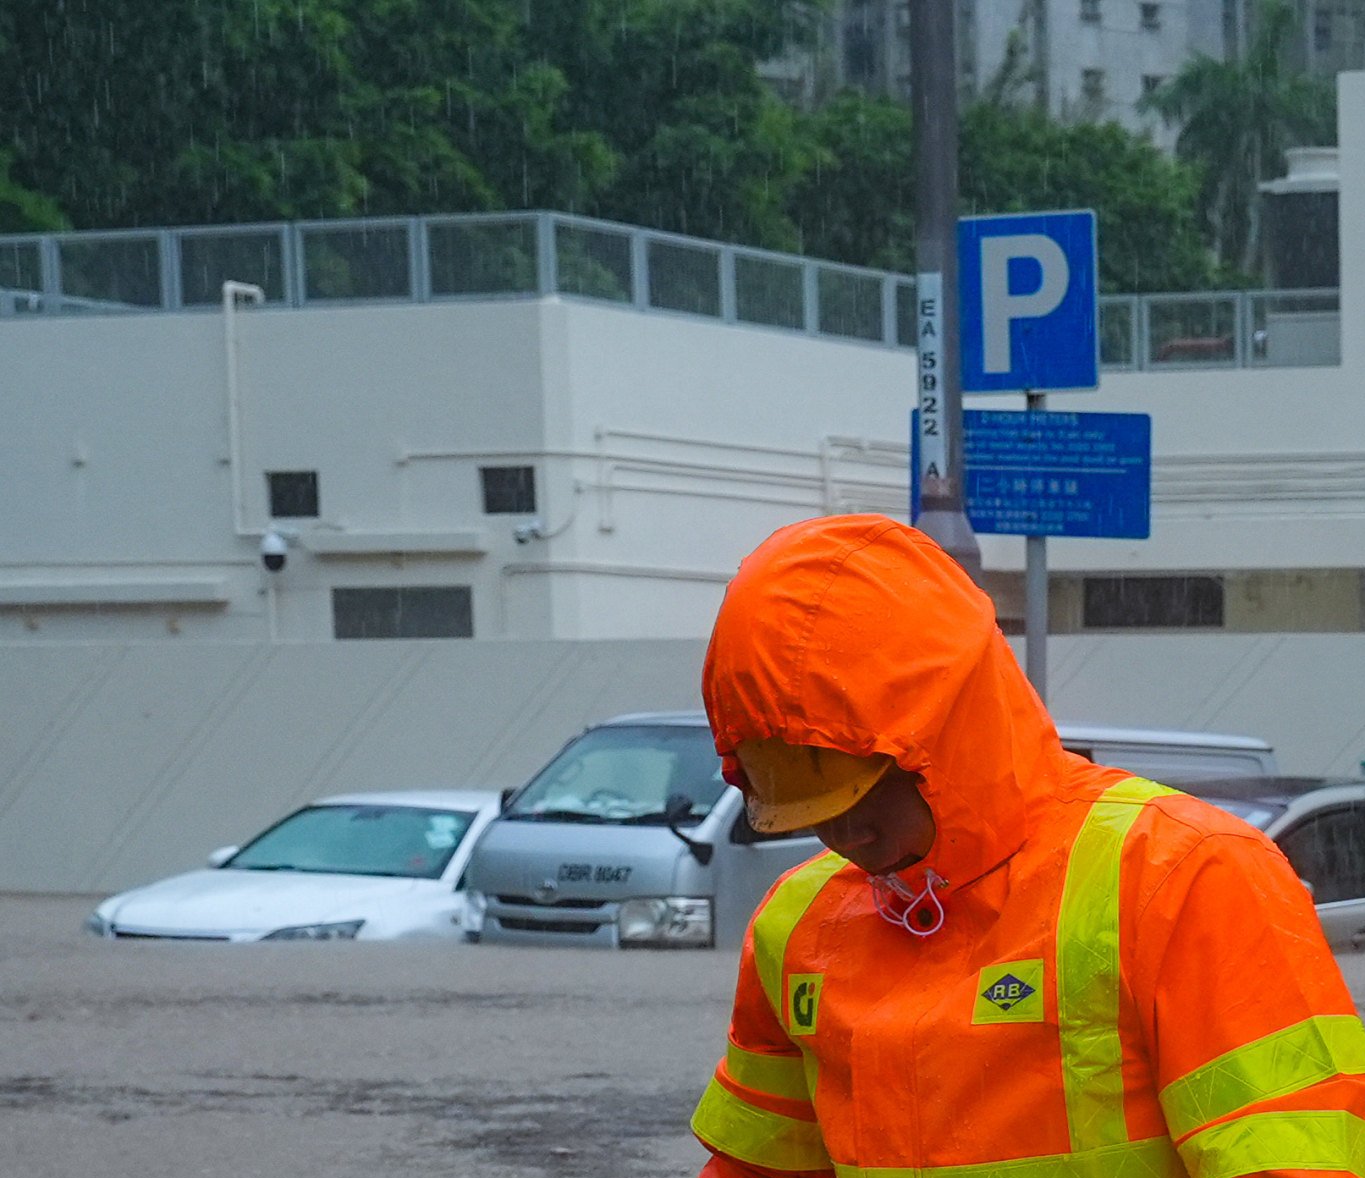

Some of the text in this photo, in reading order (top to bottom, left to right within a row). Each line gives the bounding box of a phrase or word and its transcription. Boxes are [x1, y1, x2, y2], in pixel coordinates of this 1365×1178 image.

[980, 234, 1069, 374] P
[920, 300, 940, 479] EA 5922 A
[993, 983, 1022, 999] RB
